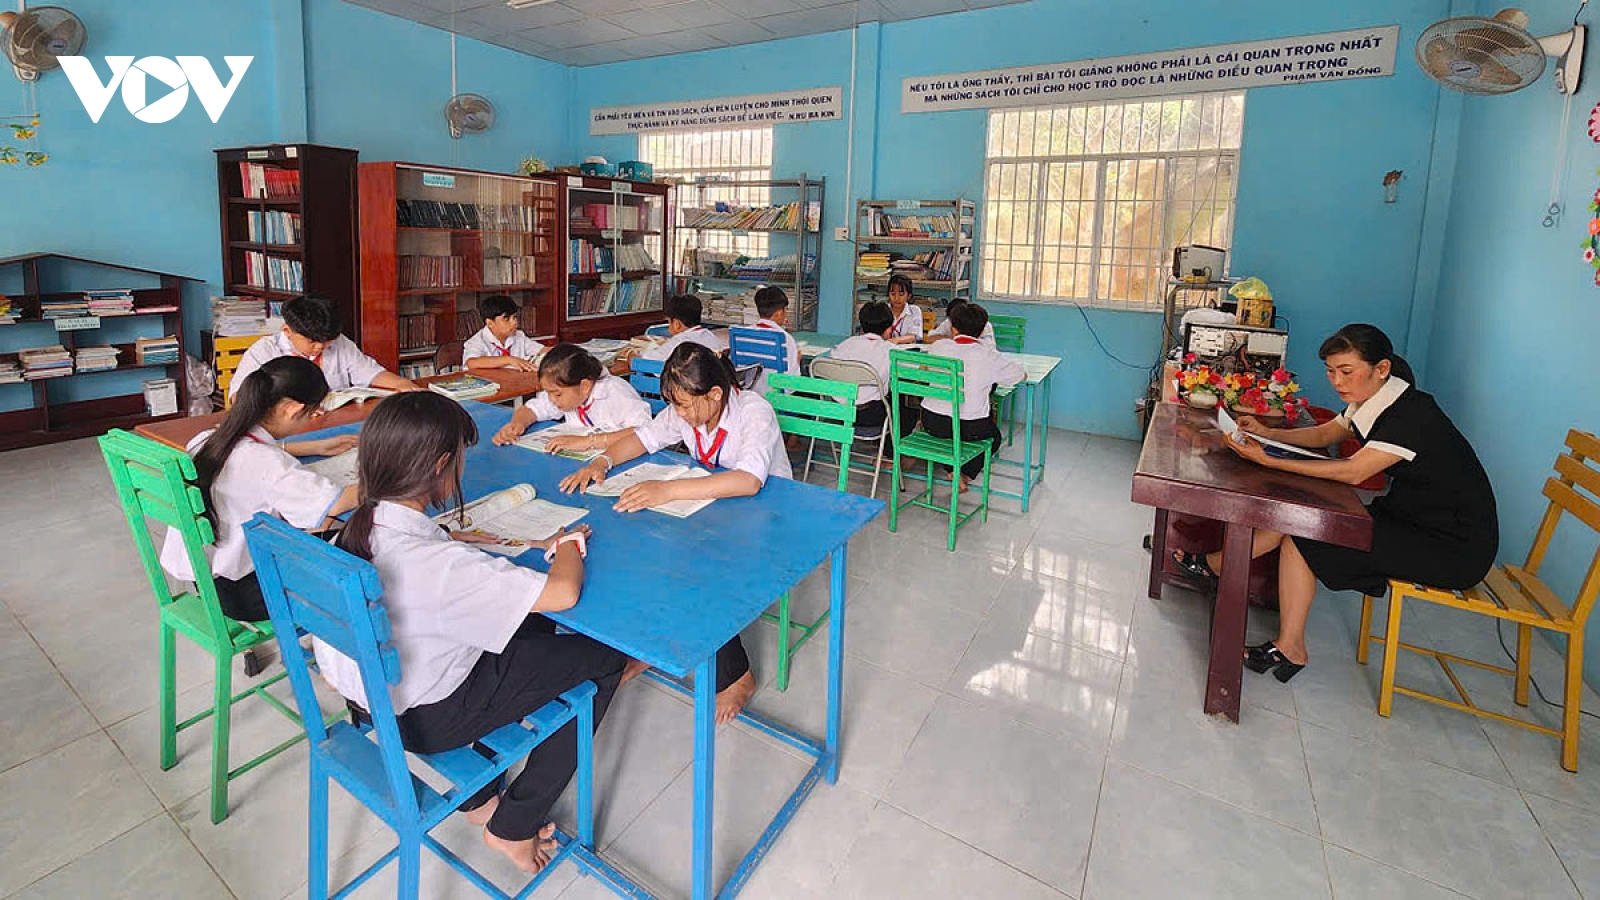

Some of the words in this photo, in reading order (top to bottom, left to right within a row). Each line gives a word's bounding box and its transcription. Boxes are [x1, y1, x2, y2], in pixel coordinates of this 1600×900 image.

[930, 81, 945, 91] TÔI
[948, 80, 960, 90] LÀ
[963, 79, 982, 89] ÔNG
[985, 75, 1014, 86] THẦY,
[1017, 73, 1034, 84] THÌ
[1037, 71, 1055, 81] BÀI
[1058, 69, 1076, 80] TÔI
[1079, 65, 1113, 77] GIẢNG
[1117, 61, 1158, 74] KHÔNG
[1161, 56, 1191, 69] PHẢI
[1195, 54, 1211, 66] LÀ
[1216, 50, 1239, 64] CÁI
[1243, 48, 1281, 61] QUAN
[1285, 43, 1336, 57] TRỌNG
[1340, 35, 1383, 51] NHẤT
[1284, 73, 1317, 81] PHẠM
[1348, 66, 1382, 76] ĐỒNG
[924, 92, 938, 103] MÀ
[941, 89, 973, 102] NHỮNG
[975, 89, 1001, 100] SÁCH
[1004, 87, 1020, 97] TÔI
[1023, 84, 1041, 96] CHỈ
[1043, 83, 1065, 94] CHO
[1068, 82, 1092, 92] HỌC
[1095, 78, 1117, 90] TRÒ
[1122, 77, 1146, 88] ĐỌC
[1150, 73, 1165, 85] LÀ
[1170, 69, 1214, 83] NHỮNG
[1218, 63, 1250, 78] ĐIỀU
[1255, 62, 1293, 76] QUAN
[1297, 57, 1349, 71] TRỌNG
[755, 101, 770, 110] CHO
[811, 95, 833, 105] QUEN
